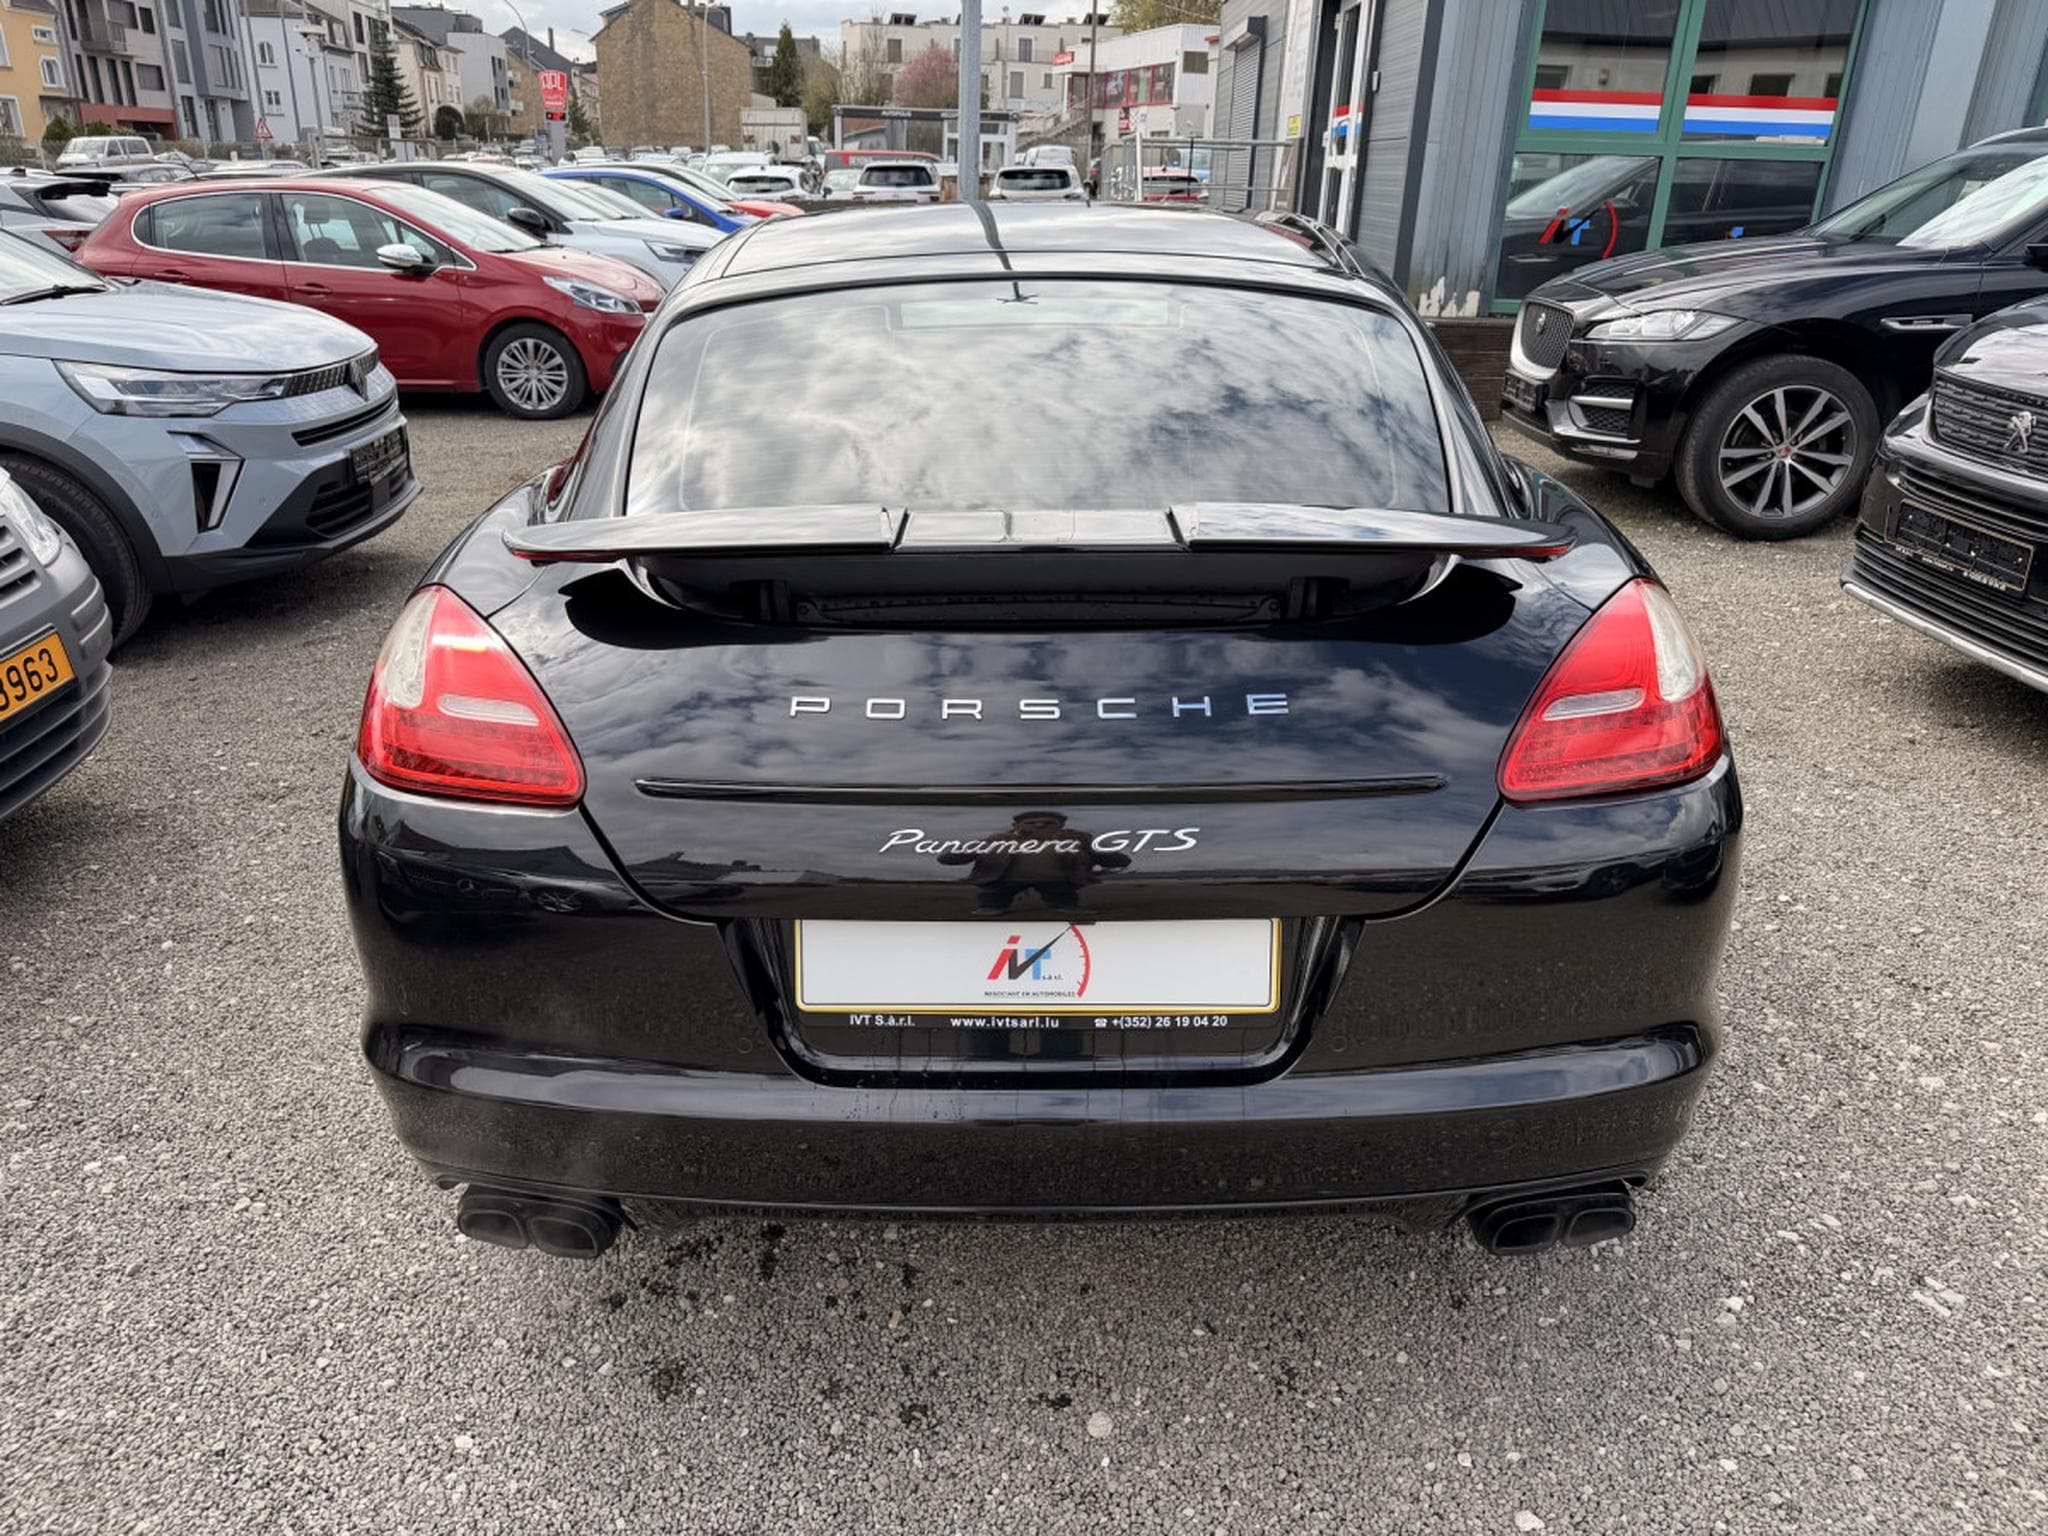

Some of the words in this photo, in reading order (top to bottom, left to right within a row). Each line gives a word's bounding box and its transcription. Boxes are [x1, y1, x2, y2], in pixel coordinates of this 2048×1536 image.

[789, 693, 1290, 721] PORSCHE
[878, 829, 1080, 854] Panamera
[1091, 827, 1201, 852] GTS
[850, 1014, 872, 1026] IVT
[950, 1016, 1060, 1029] www.ivtsarl.lu
[1155, 1016, 1171, 1027] 26
[1175, 1016, 1190, 1028] 19
[1193, 1016, 1209, 1027] 04
[1212, 1015, 1228, 1027] 20
